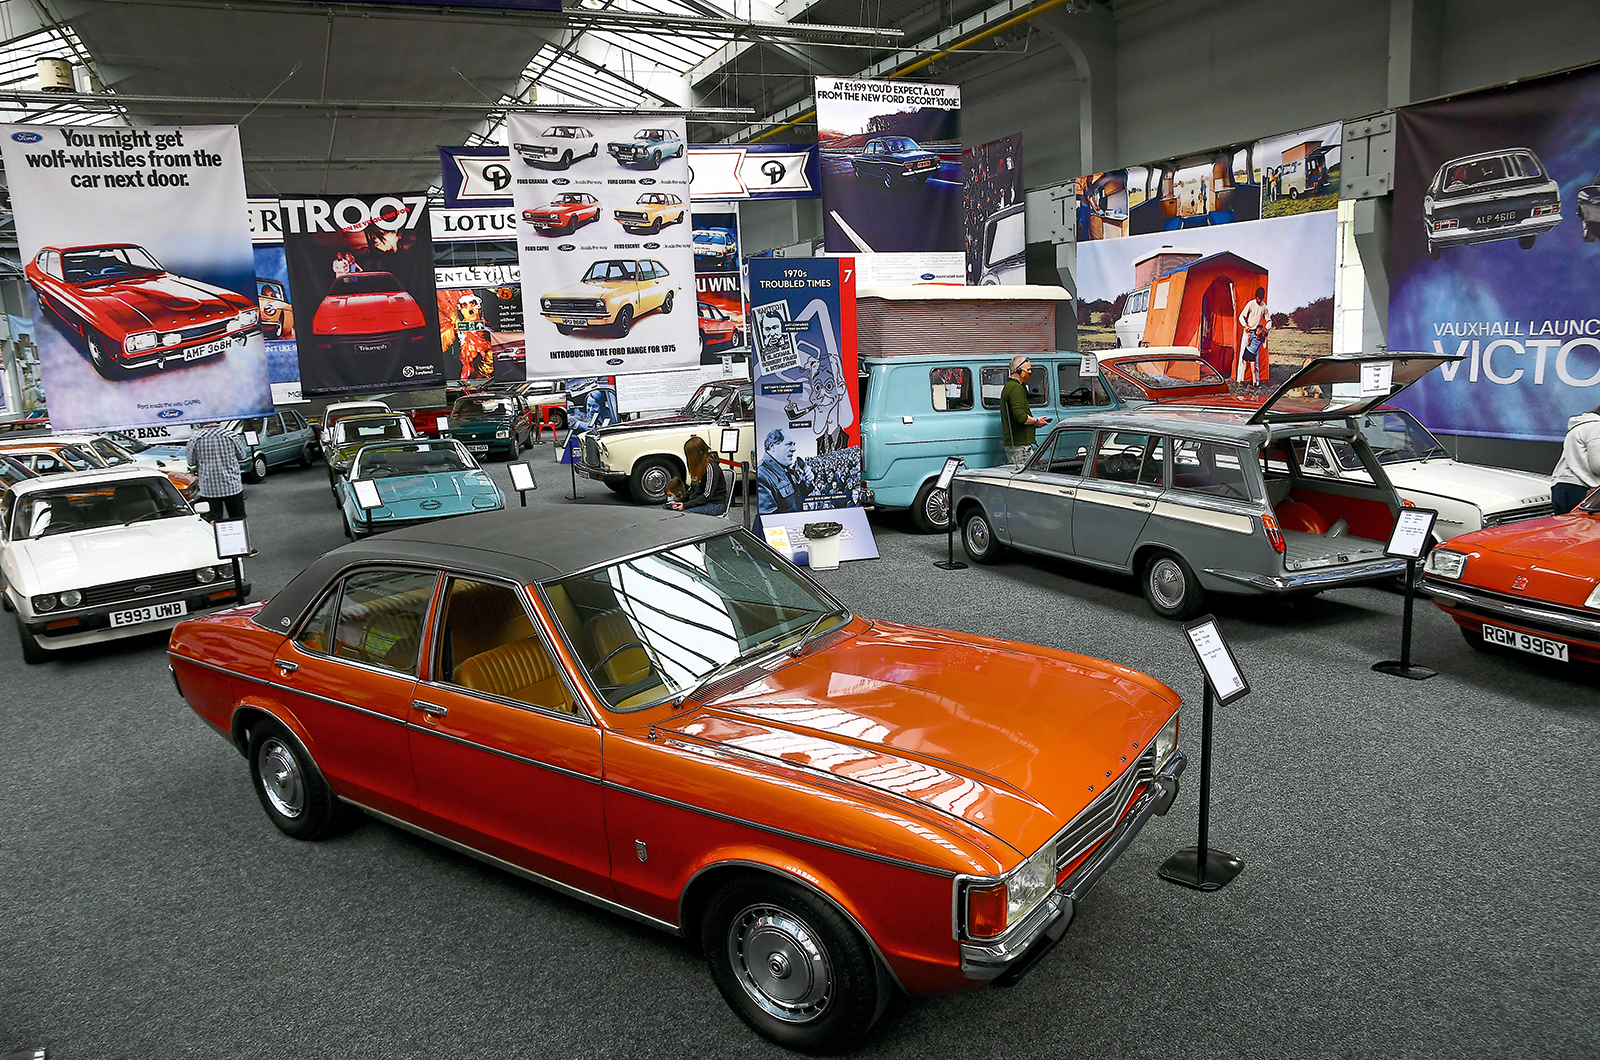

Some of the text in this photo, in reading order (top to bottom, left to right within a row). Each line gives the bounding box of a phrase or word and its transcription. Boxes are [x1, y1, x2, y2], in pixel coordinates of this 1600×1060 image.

[818, 90, 842, 100] FROM
[844, 92, 859, 101] THE
[861, 93, 880, 102] NEW
[882, 94, 904, 104] FORD
[906, 96, 936, 105] ESCORT
[834, 82, 843, 90] AT
[867, 84, 892, 94] YOU'D
[894, 86, 922, 95] EXPECT
[923, 87, 929, 96] A
[931, 88, 945, 97] LOT
[60, 129, 184, 150] You might get
[25, 150, 222, 168] wolf-whistles from the
[70, 170, 189, 188] car next door.
[444, 213, 516, 232] LOTUS
[1476, 215, 1492, 225] ALP
[783, 270, 807, 278] 1970s
[844, 269, 853, 283] 7
[708, 277, 740, 292] WIN.
[760, 279, 831, 289] TROUBLED TIMES
[1433, 319, 1600, 337] VAUXHALL LAUNC
[186, 340, 232, 359] AMF 368H
[550, 344, 676, 359] INTRODUCING THE FORD RANGE FOR 1975
[1432, 338, 1600, 387] VICTO
[138, 426, 171, 438] BAYS.
[115, 603, 181, 625] E993 UWB
[1484, 626, 1566, 659] RGM 996Y
